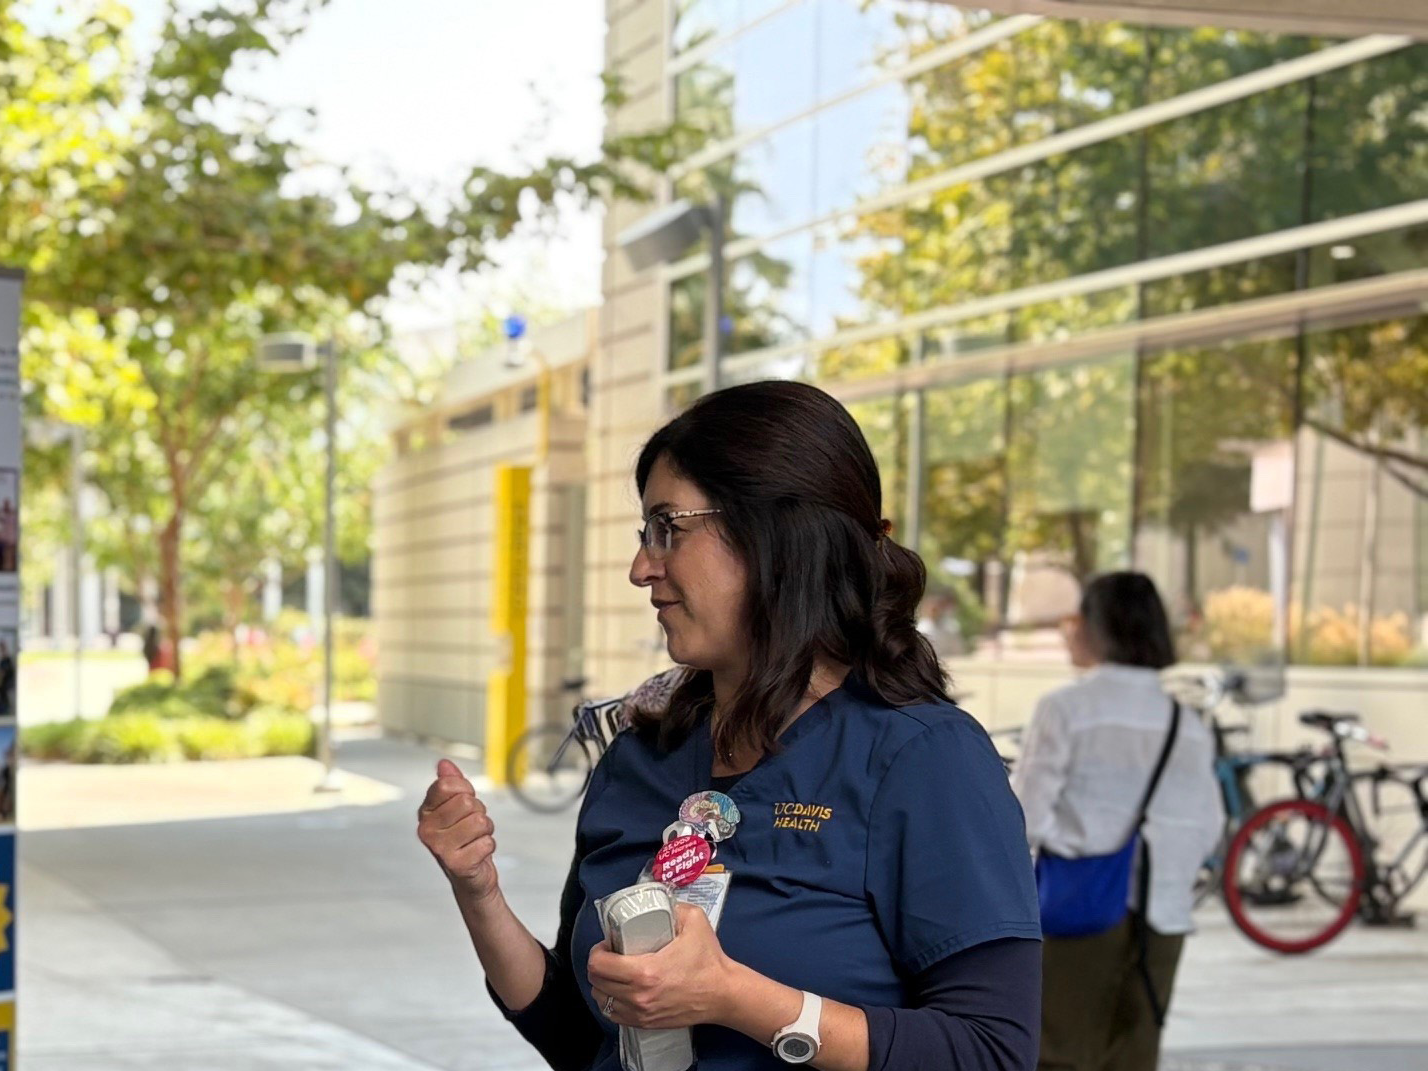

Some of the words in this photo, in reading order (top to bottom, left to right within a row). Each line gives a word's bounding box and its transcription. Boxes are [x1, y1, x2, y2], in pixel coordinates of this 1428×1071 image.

[774, 817, 820, 832] HEALTH
[662, 871, 673, 881] to
[676, 852, 704, 873] Fight
[663, 847, 696, 871] Ready
